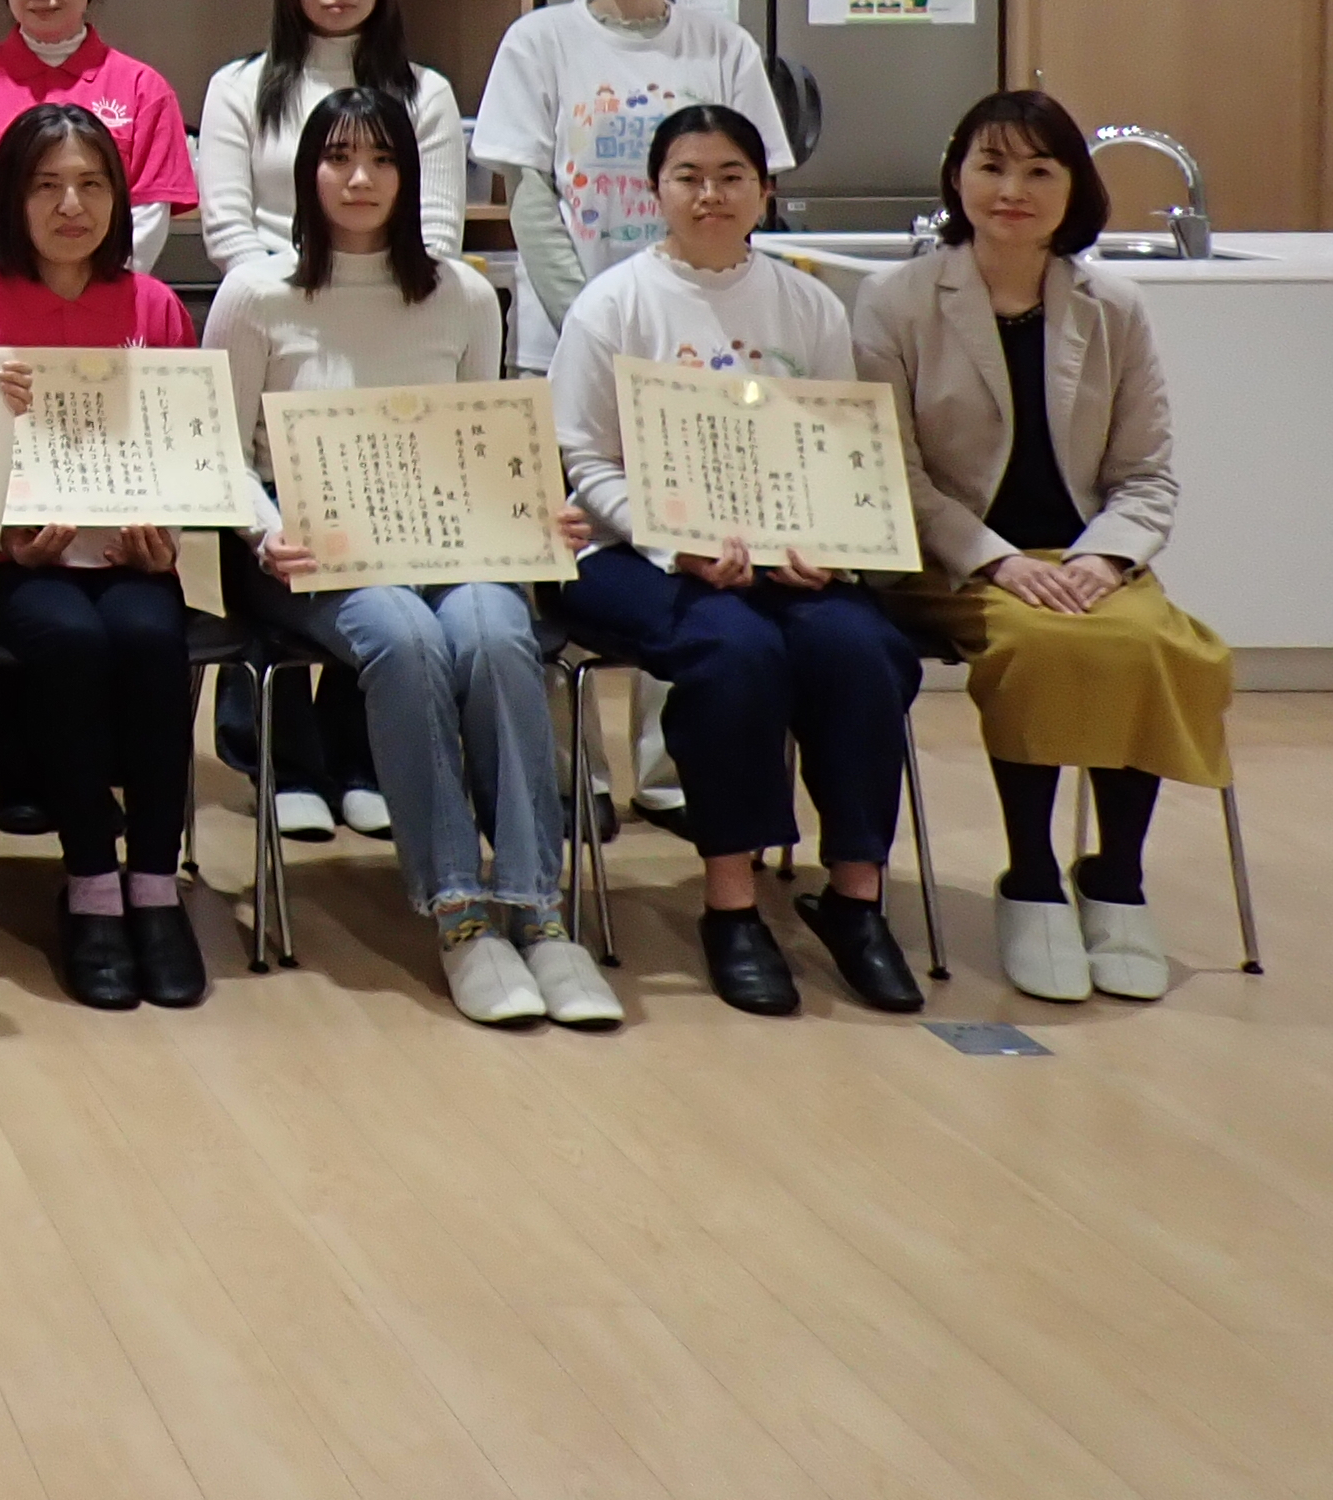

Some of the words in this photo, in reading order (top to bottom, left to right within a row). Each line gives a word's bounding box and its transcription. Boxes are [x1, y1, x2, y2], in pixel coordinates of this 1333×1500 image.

[189, 417, 214, 472] 賞状
[507, 456, 532, 519] 賞状
[848, 450, 877, 508] 賞状
